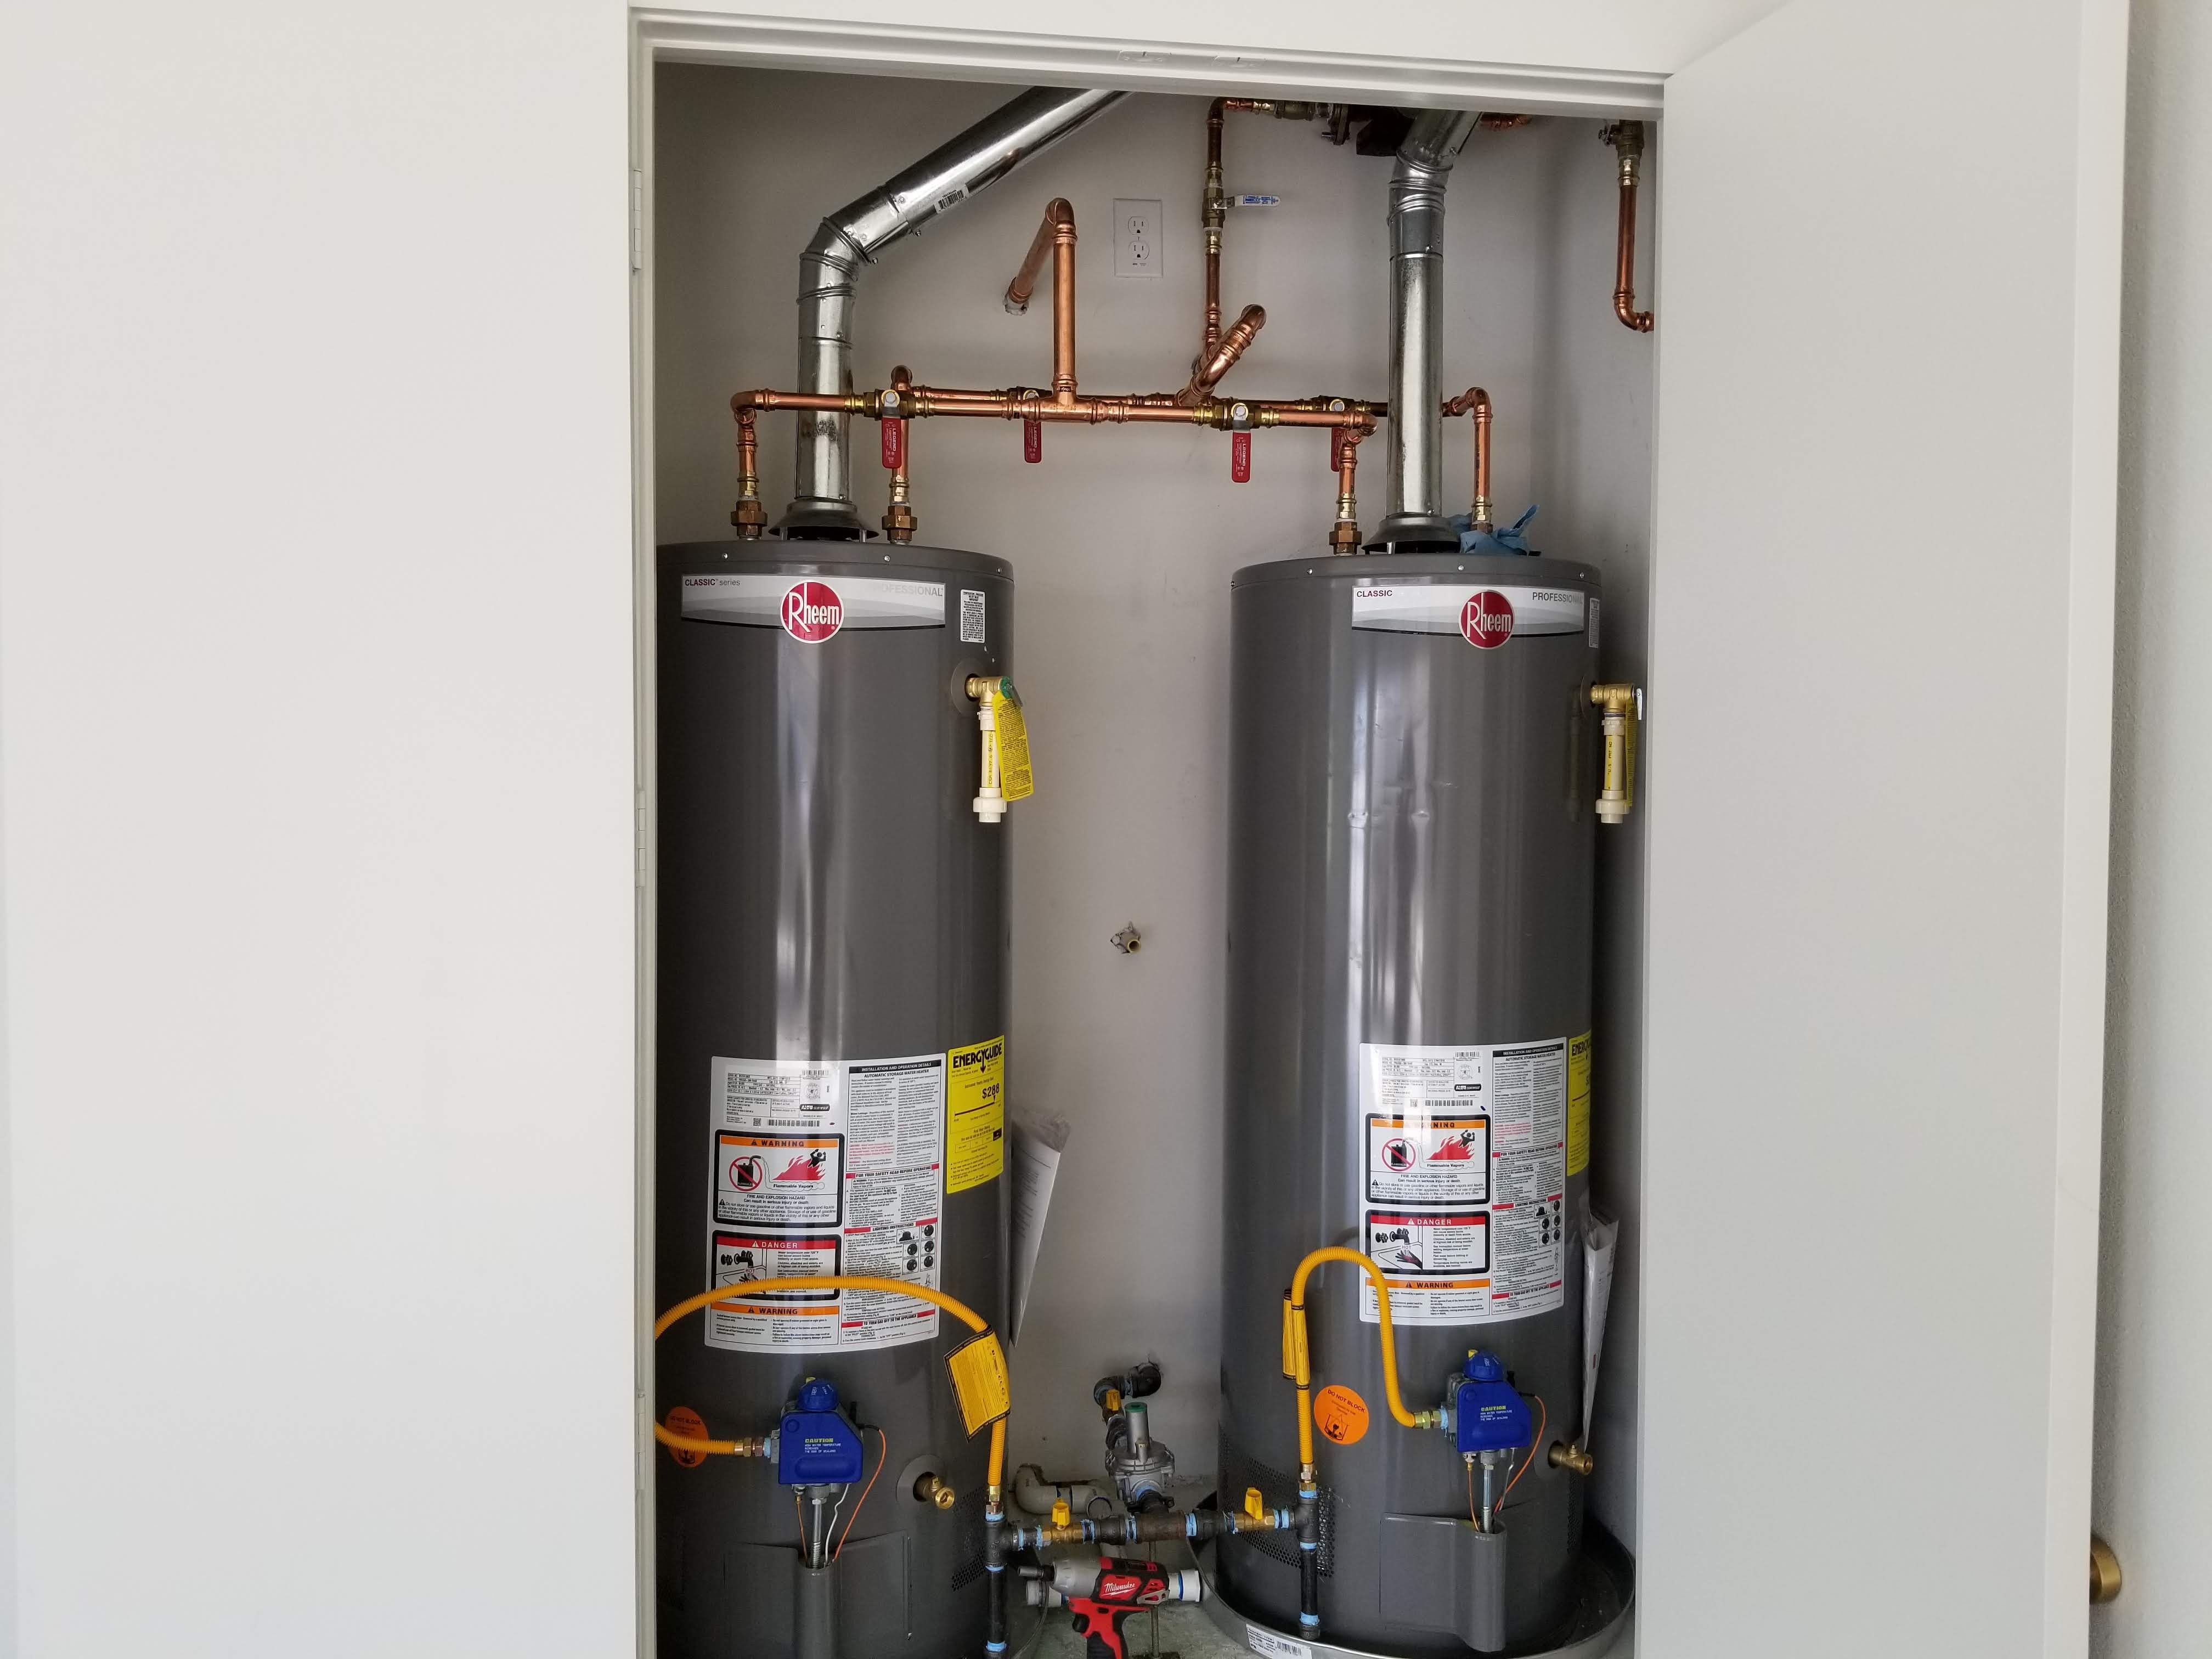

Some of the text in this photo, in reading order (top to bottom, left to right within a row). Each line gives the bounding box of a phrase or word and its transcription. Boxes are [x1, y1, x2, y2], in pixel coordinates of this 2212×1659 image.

[789, 582, 840, 633] Rheem
[1466, 592, 1511, 639] Rheem
[953, 1042, 1002, 1068] ENERGYGUIDE
[982, 1082, 1000, 1099] $288
[1336, 1394, 1347, 1402] NOT
[1347, 1400, 1365, 1413] BLOCK
[1104, 1581, 1135, 1593] Milwaukee
